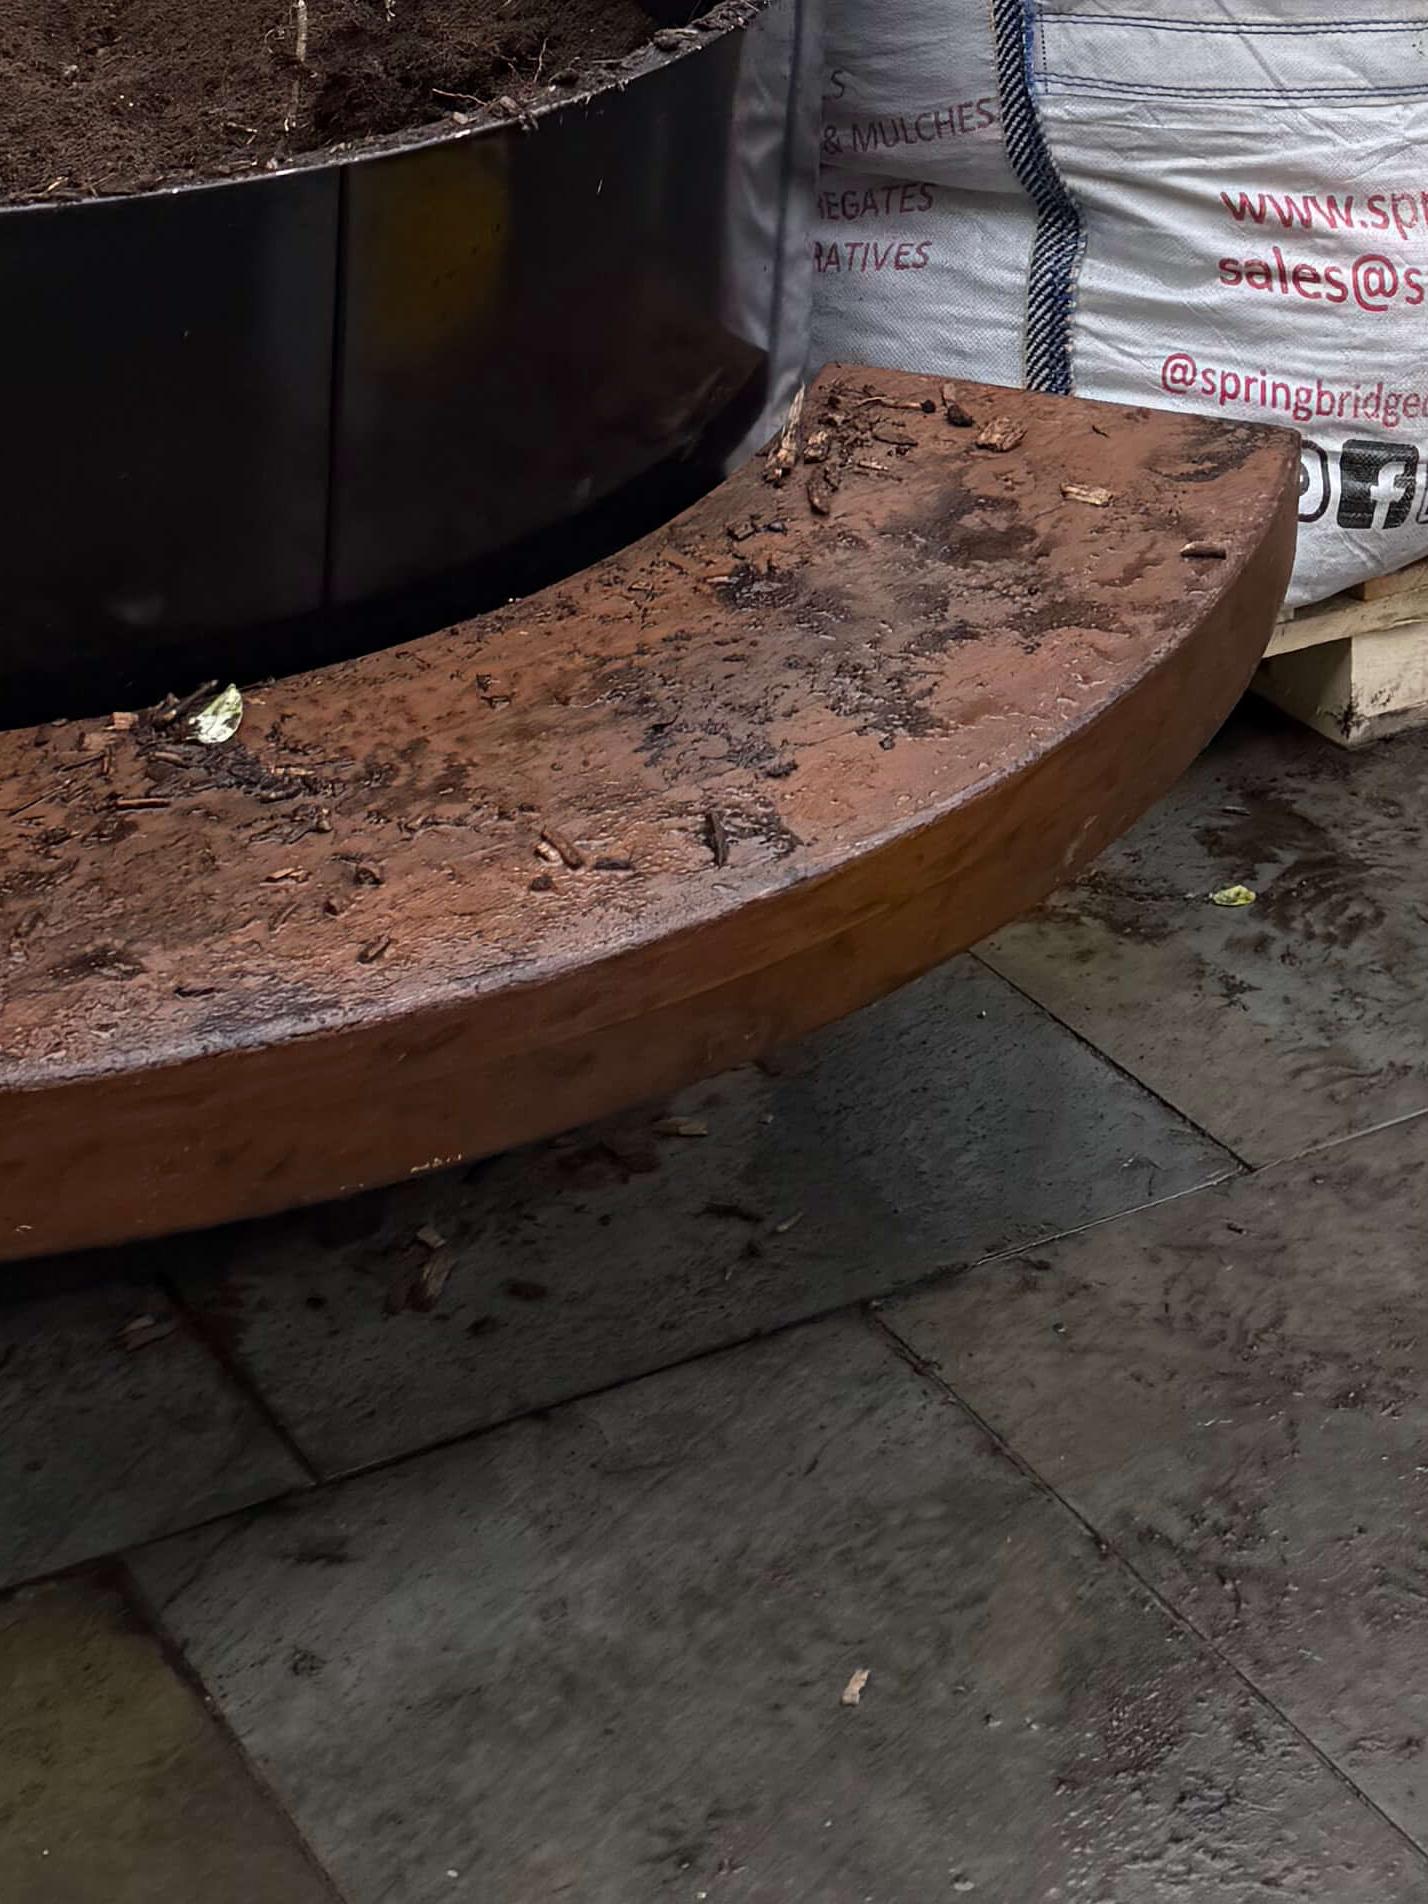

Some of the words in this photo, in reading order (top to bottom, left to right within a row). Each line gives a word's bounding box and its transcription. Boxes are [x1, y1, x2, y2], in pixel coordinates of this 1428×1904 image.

[822, 124, 843, 155] &
[851, 97, 996, 153] MULCHES
[818, 182, 936, 221] EGATES
